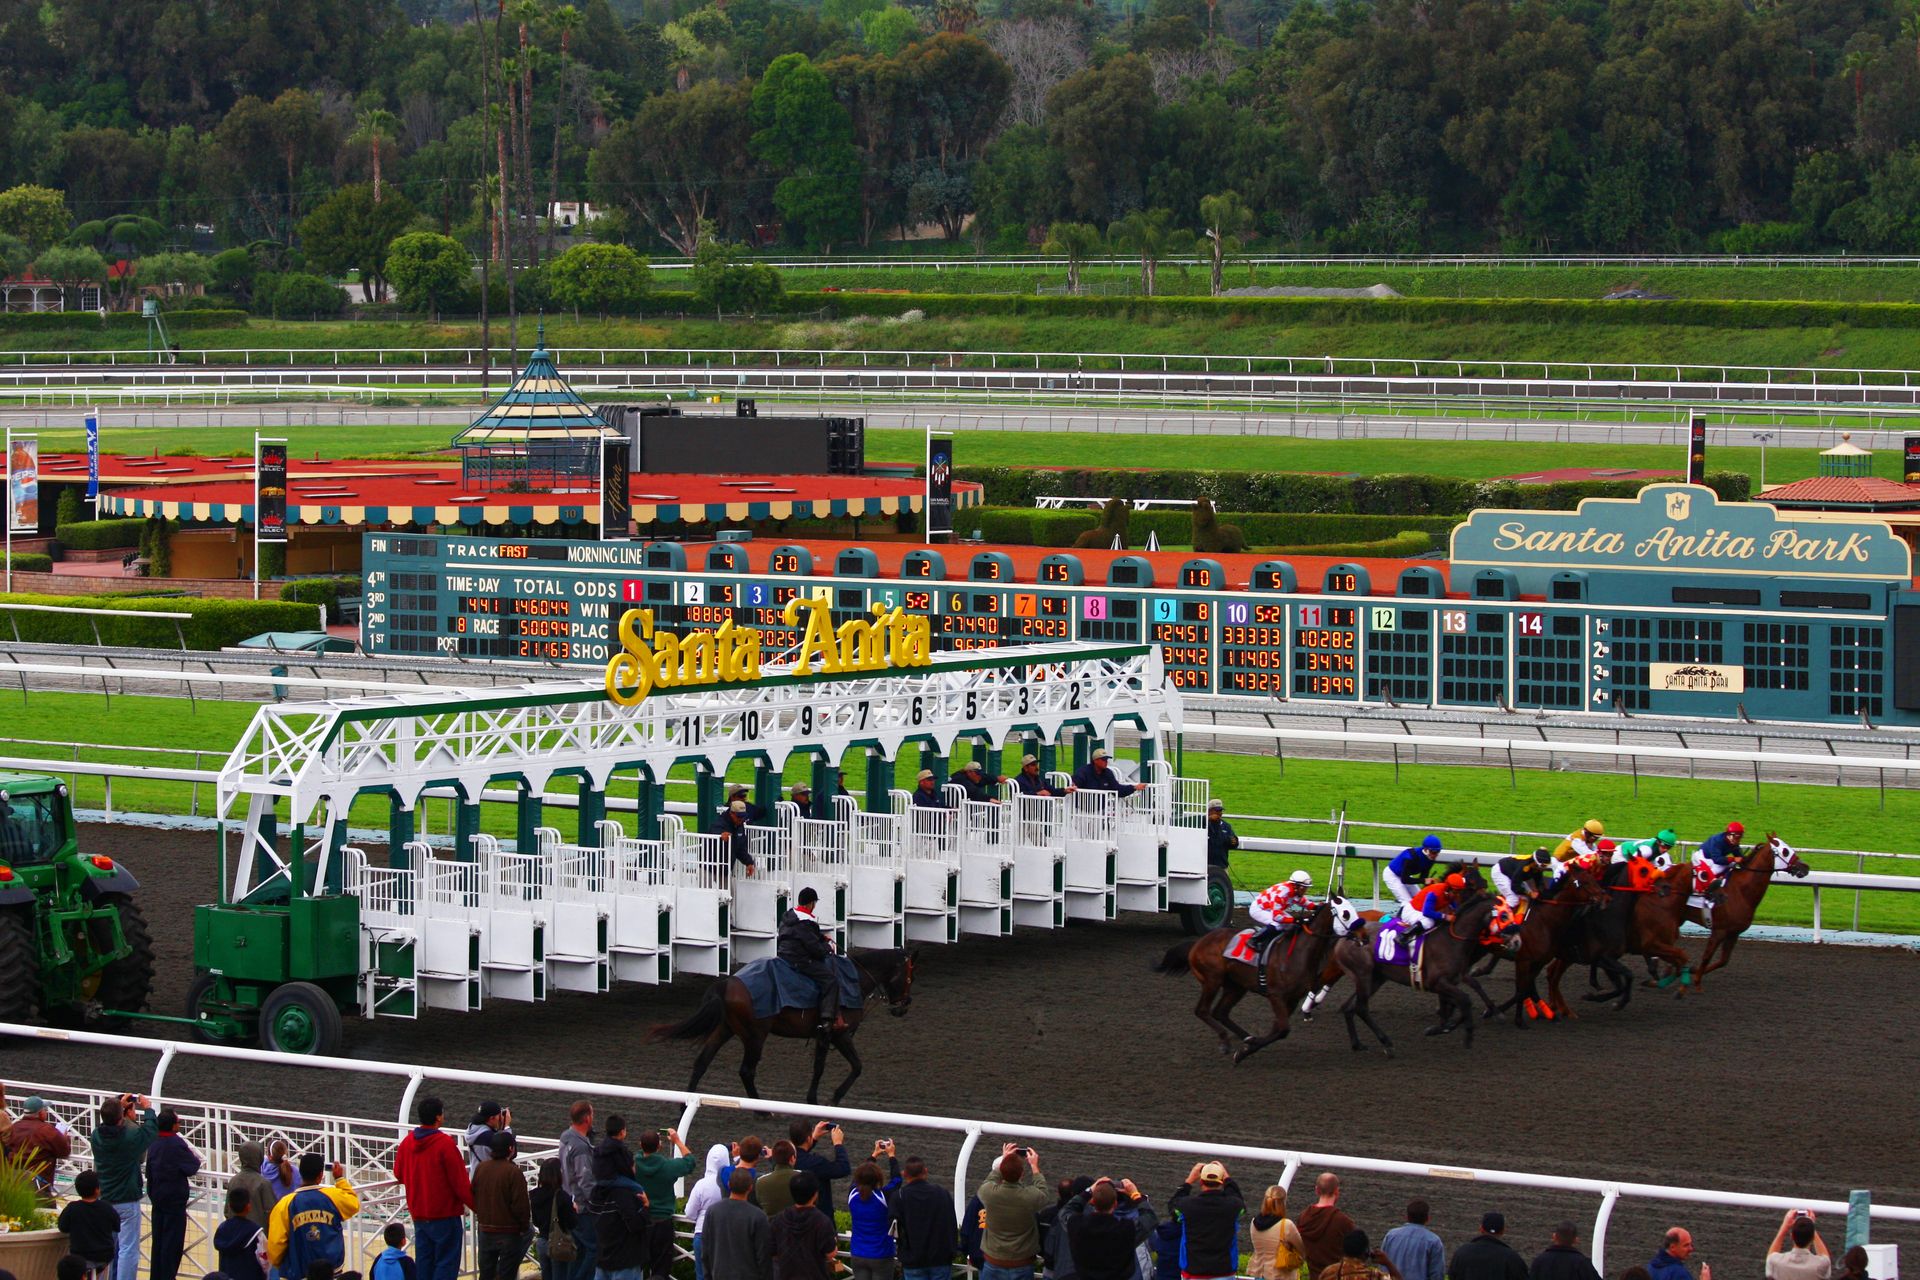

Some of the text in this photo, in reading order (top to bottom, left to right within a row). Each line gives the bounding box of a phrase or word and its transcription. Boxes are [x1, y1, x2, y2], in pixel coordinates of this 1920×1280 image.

[371, 540, 386, 552] FIN
[1493, 522, 1868, 562] Santa Anita Park
[447, 544, 528, 558] TRACK FAST
[568, 546, 642, 564] MORNING LINE
[724, 554, 733, 568] 4
[775, 555, 797, 572] 20
[921, 560, 930, 576] 2
[990, 563, 998, 578] 3
[1049, 565, 1068, 581] 15
[1190, 570, 1209, 586] 10
[367, 572, 385, 588] 4TH
[514, 578, 564, 595] TOTAL
[1272, 572, 1281, 588] 5
[1336, 574, 1356, 591] 10
[574, 581, 617, 599] ODDS
[628, 582, 636, 600] 1
[689, 584, 698, 602] 2
[724, 586, 732, 602] 5
[752, 586, 762, 604] 3
[778, 588, 797, 604] 15
[367, 592, 385, 608] 3RD
[514, 598, 569, 615] 146044
[885, 591, 894, 609] 5
[951, 593, 962, 612] 6
[989, 596, 998, 612] 3
[1020, 596, 1030, 614] 7
[1042, 598, 1067, 614] 41
[1090, 599, 1100, 617] 8
[580, 602, 609, 618] WIN
[687, 606, 732, 622] 18869
[756, 608, 785, 624] 764
[1160, 601, 1170, 620] 9
[1198, 603, 1208, 620] 8
[1228, 604, 1247, 624] 10
[1300, 607, 1321, 626] 11
[1334, 609, 1354, 625] 11
[368, 612, 386, 628] 2ND
[458, 617, 465, 632] 8
[473, 618, 500, 634] RACE
[944, 616, 997, 634] 27490
[1374, 610, 1393, 628] 12
[1443, 612, 1466, 631] 13
[1519, 614, 1542, 634] 14
[520, 620, 569, 636] 50094
[571, 623, 609, 639] PLAC
[1023, 620, 1066, 637] 2923
[1158, 624, 1208, 642] 12451
[1224, 627, 1280, 645] 33333
[370, 633, 384, 650] 1ST
[437, 636, 460, 652] POST
[757, 630, 796, 647] 2025
[1302, 630, 1354, 648] 10282
[605, 596, 932, 706] Santa Anita
[1164, 647, 1208, 665] 3442
[1229, 650, 1280, 668] 11405
[1309, 652, 1354, 670] 3474
[1235, 674, 1280, 691] 4323
[1314, 676, 1354, 694] 1399
[1665, 675, 1729, 690] SANTA ANITA PARK
[1018, 686, 1028, 716] 3
[1070, 682, 1080, 710] 2
[912, 696, 923, 726] 6
[966, 692, 977, 720] 5
[802, 706, 813, 736] 9
[858, 701, 870, 730] 7
[682, 716, 700, 747] 11
[740, 710, 759, 741] 10
[1378, 928, 1397, 960] 10
